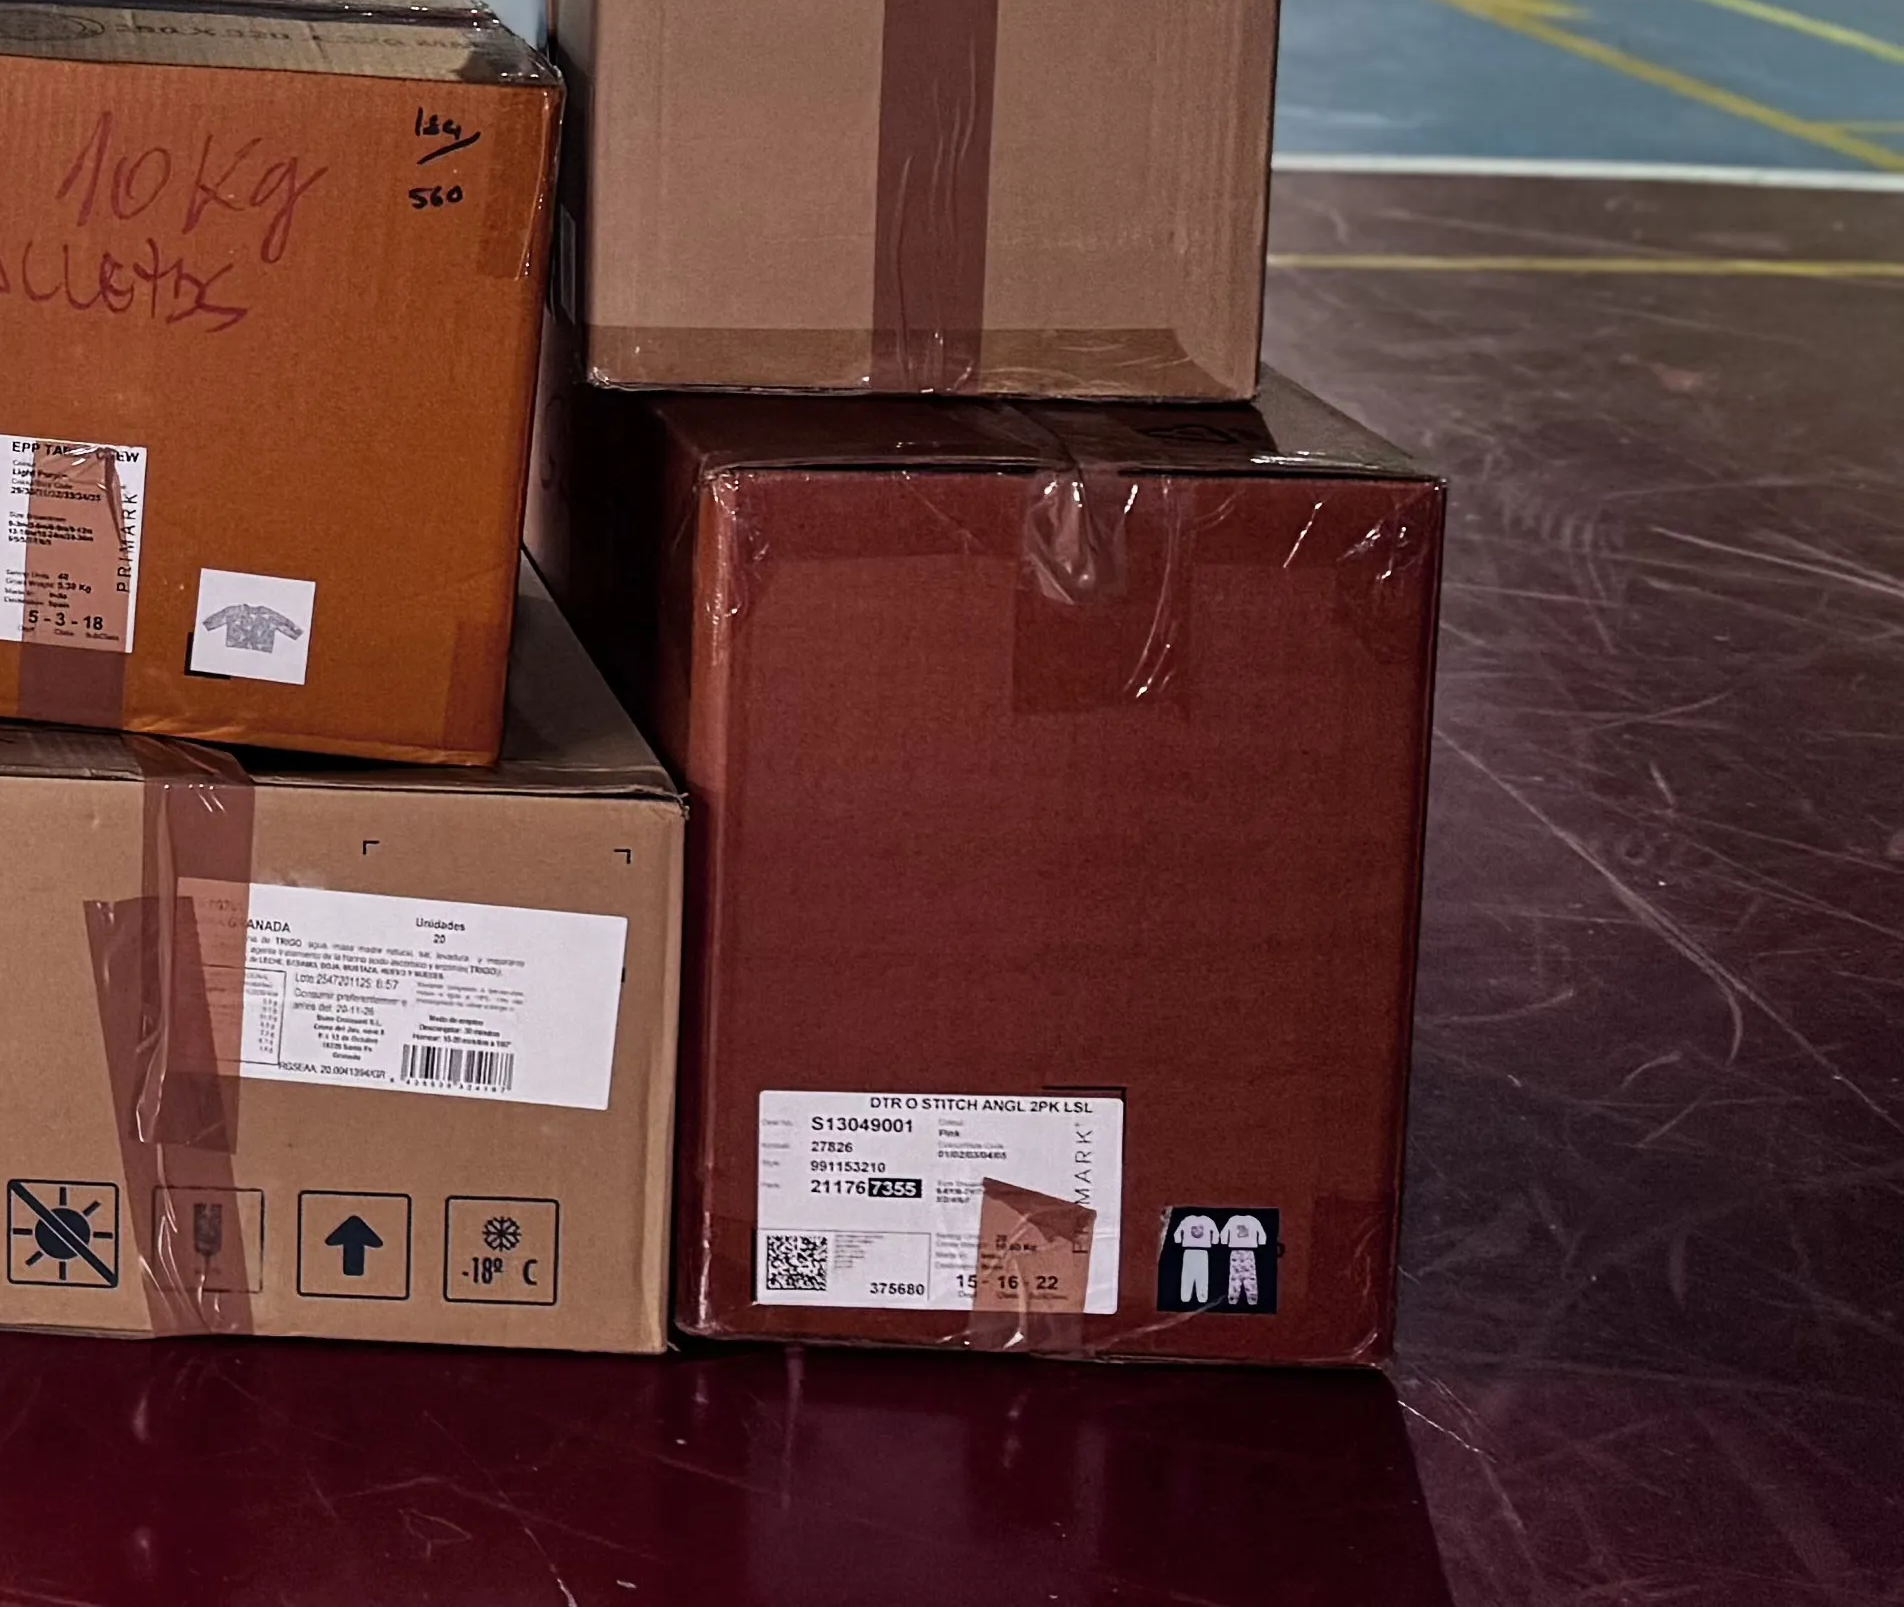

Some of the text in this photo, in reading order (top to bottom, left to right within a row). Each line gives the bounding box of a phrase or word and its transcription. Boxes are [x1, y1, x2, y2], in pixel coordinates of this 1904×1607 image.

[57, 110, 329, 263] 10 Kg
[408, 186, 463, 209] 560
[12, 441, 40, 453] EPP
[116, 494, 138, 593] PRIMARK
[28, 609, 39, 623] 5
[55, 612, 66, 626] 3
[83, 615, 103, 630] 18
[416, 917, 466, 931] Unidades
[870, 1097, 1093, 1113] DTR O STITCH ANGL 2PK LSL
[811, 1116, 913, 1132] S13049001
[811, 1141, 853, 1152] 27826
[810, 1160, 886, 1173] 991153210
[869, 1282, 925, 1296] 375680
[956, 1274, 977, 1289] 15
[997, 1275, 1019, 1290] 16
[1036, 1275, 1059, 1290] 22
